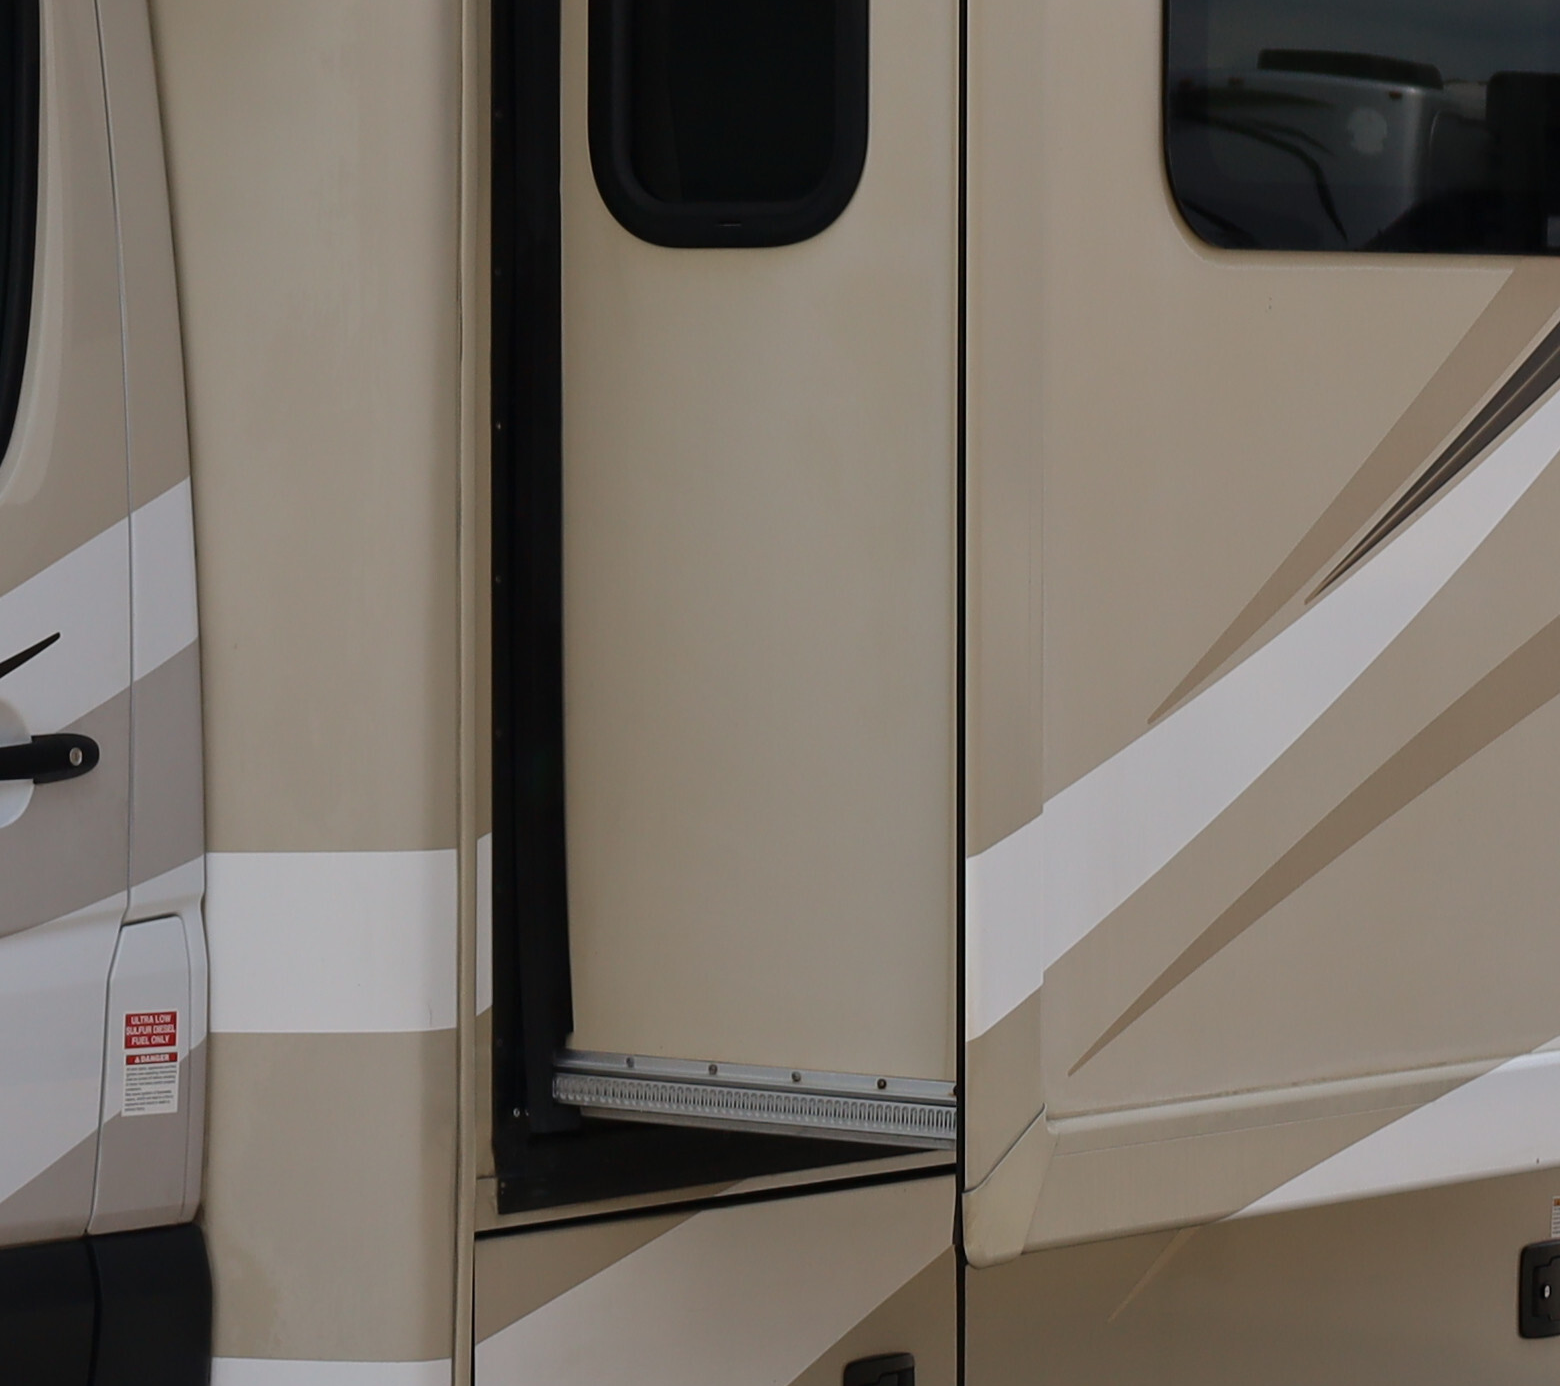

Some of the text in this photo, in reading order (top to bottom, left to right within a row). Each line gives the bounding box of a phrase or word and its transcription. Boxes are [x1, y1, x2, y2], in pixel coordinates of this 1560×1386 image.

[130, 1014, 172, 1024] ULTRA LOW
[126, 1023, 175, 1035] SULFUR DIESEL
[131, 1034, 170, 1045] FUEL ONLY
[140, 1053, 170, 1063] DANGER
